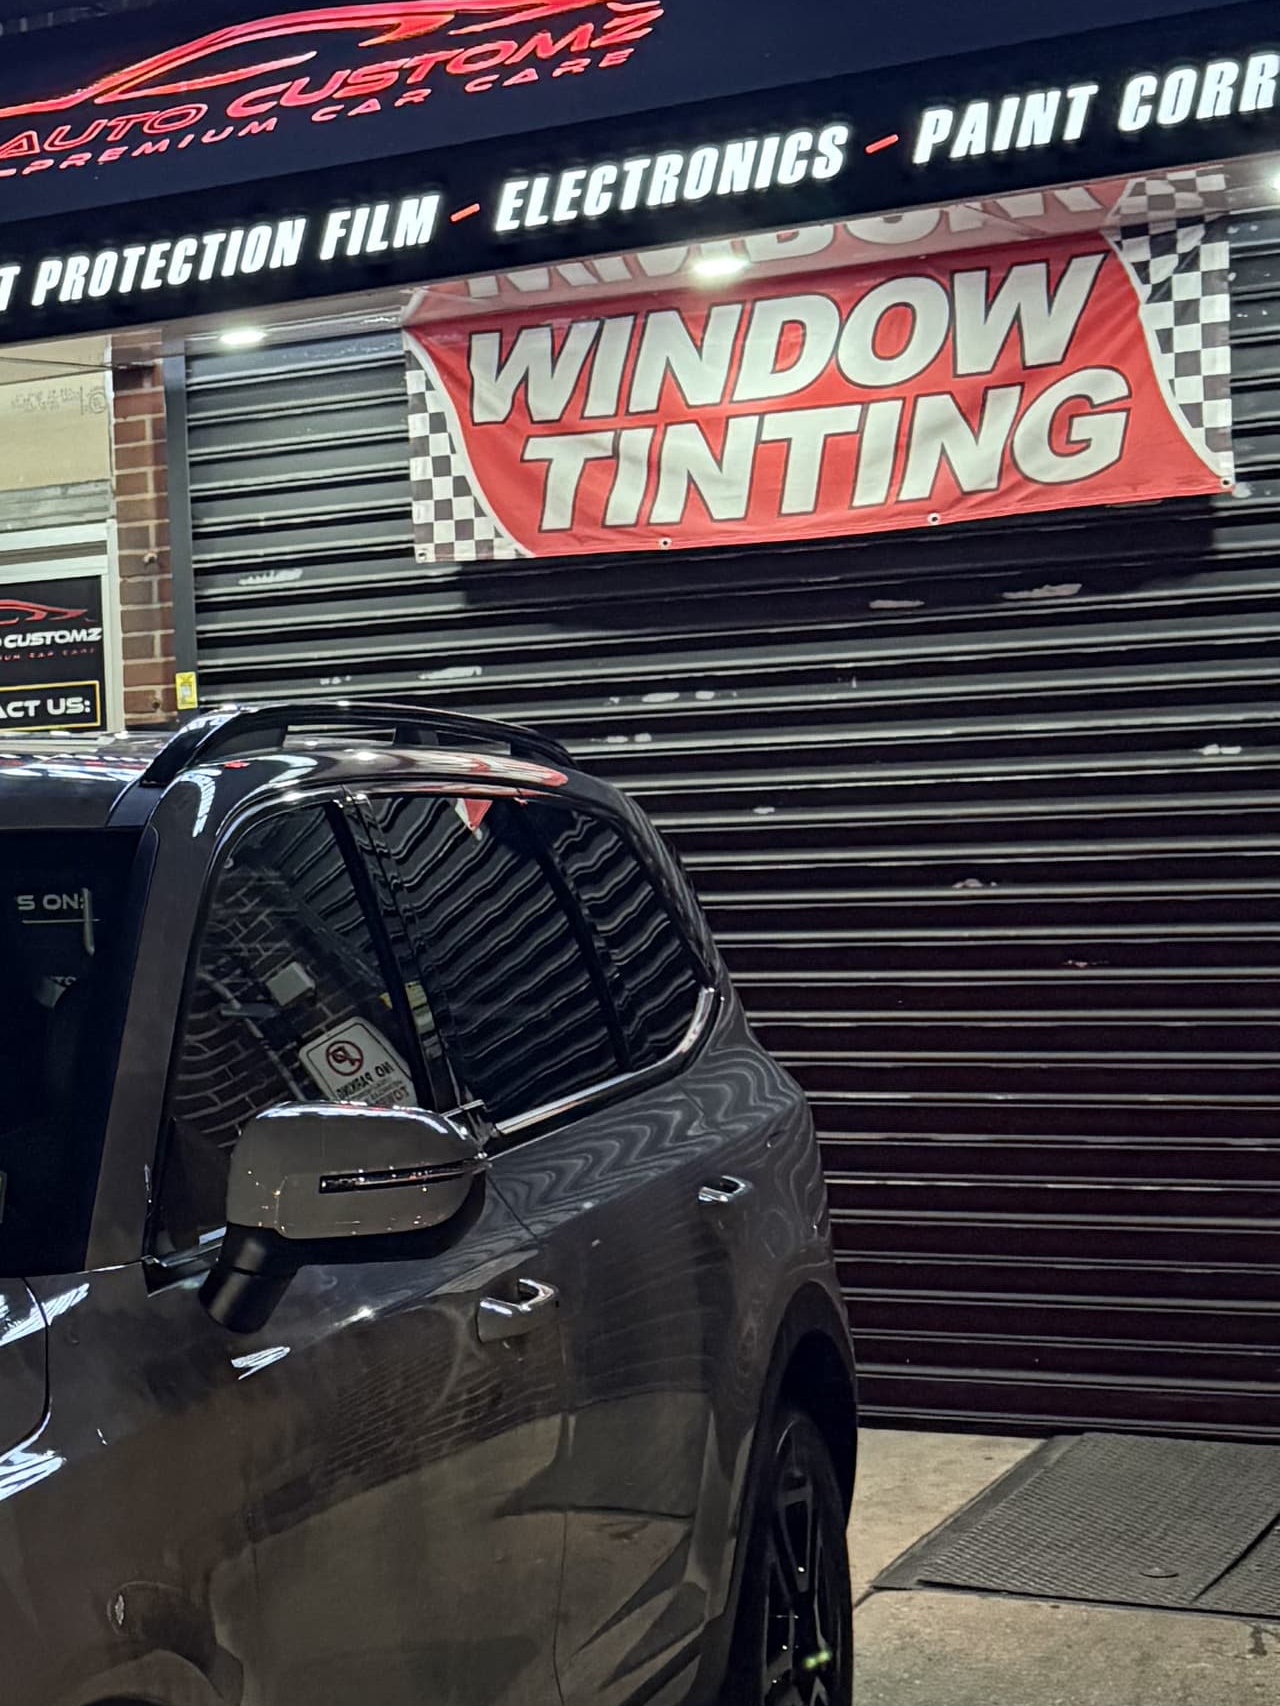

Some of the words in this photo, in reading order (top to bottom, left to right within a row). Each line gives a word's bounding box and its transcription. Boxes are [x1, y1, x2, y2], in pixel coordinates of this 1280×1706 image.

[23, 120, 278, 175] PREMIUM
[312, 89, 432, 122] CAR
[463, 50, 636, 94] CARE
[226, 7, 663, 119] CUSTOMZ
[31, 217, 308, 306] PROTECTION
[319, 194, 441, 261] FILM
[492, 123, 850, 233] ELECTRONICS
[911, 83, 1099, 165] PAINT
[1117, 50, 1280, 132] CORR
[469, 254, 1110, 424] WINDOW
[521, 367, 1130, 533] TINTING
[4, 627, 103, 647] CUSTOMZ
[47, 697, 91, 715] US:
[17, 894, 36, 911] S
